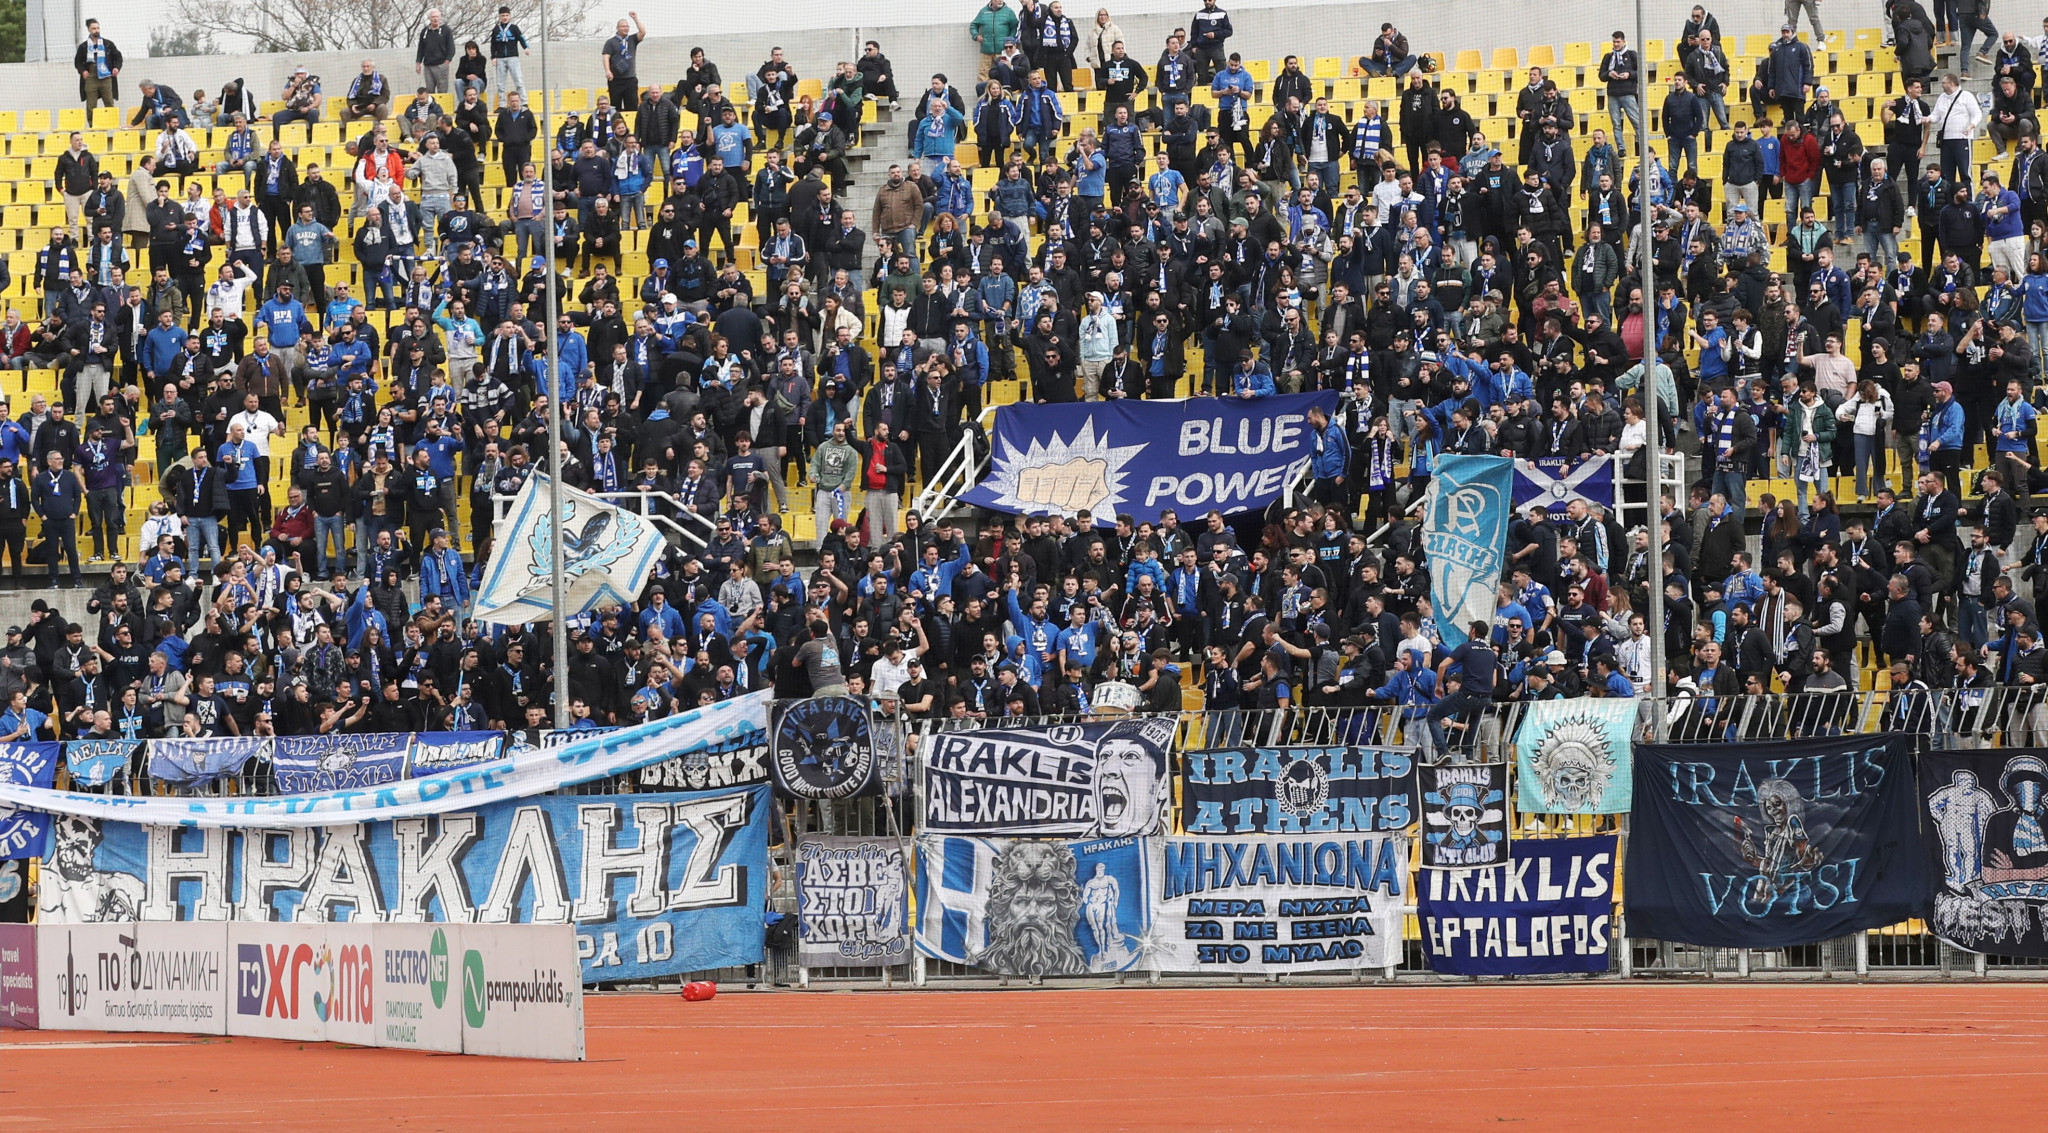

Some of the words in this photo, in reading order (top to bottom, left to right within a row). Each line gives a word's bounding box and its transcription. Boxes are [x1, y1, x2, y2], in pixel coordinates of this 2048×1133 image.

[1178, 414, 1304, 456] BLUE
[282, 732, 399, 755] ΗΡΑΚΛΗΣ
[1145, 725, 1167, 743] 1908
[641, 746, 768, 788] BRNX
[779, 749, 800, 780] GOOD
[791, 776, 822, 798] NIGHT
[823, 776, 858, 798] WHITE
[853, 746, 870, 781] PRIDE
[929, 734, 1093, 786] IRAKLIS
[1189, 747, 1414, 784] IRAKLIS
[1667, 745, 1887, 808] IRAKLIS
[275, 764, 394, 793] ΕΠΑΡΧΙΑ
[928, 775, 1097, 823] ALEXANDRIA
[1190, 793, 1414, 833] ATHENS
[137, 791, 750, 925] ΗΡΑΚΛΗΣ
[1084, 837, 1134, 855] ΗΡΑΚΛΗΣ
[1162, 837, 1402, 902] ΜΗΧΑΝΙΩΝΑ
[1698, 857, 1862, 918] VOTSI
[1187, 898, 1265, 917] ΜΕΡΑ
[1279, 895, 1373, 915] ΝΥΧΤΑ
[1185, 921, 1223, 940] ΖΩ
[1233, 920, 1277, 940] ΜΕ
[1292, 917, 1374, 938] ΕΣΕΝΑ
[1426, 914, 1608, 958] EPTALOFOS
[2, 947, 19, 963] travel
[385, 949, 428, 985] ELECTRO
[431, 955, 447, 982] NET
[576, 932, 622, 967] ΡΑ
[1198, 944, 1250, 965] ΣΤΟ
[1262, 940, 1363, 963] ΜΥΑΛΟ
[154, 1000, 158, 1016] &
[190, 1001, 213, 1021] logistics
[386, 1001, 422, 1019] ΠΑΜΠΟΥΚΙΔΗΣ
